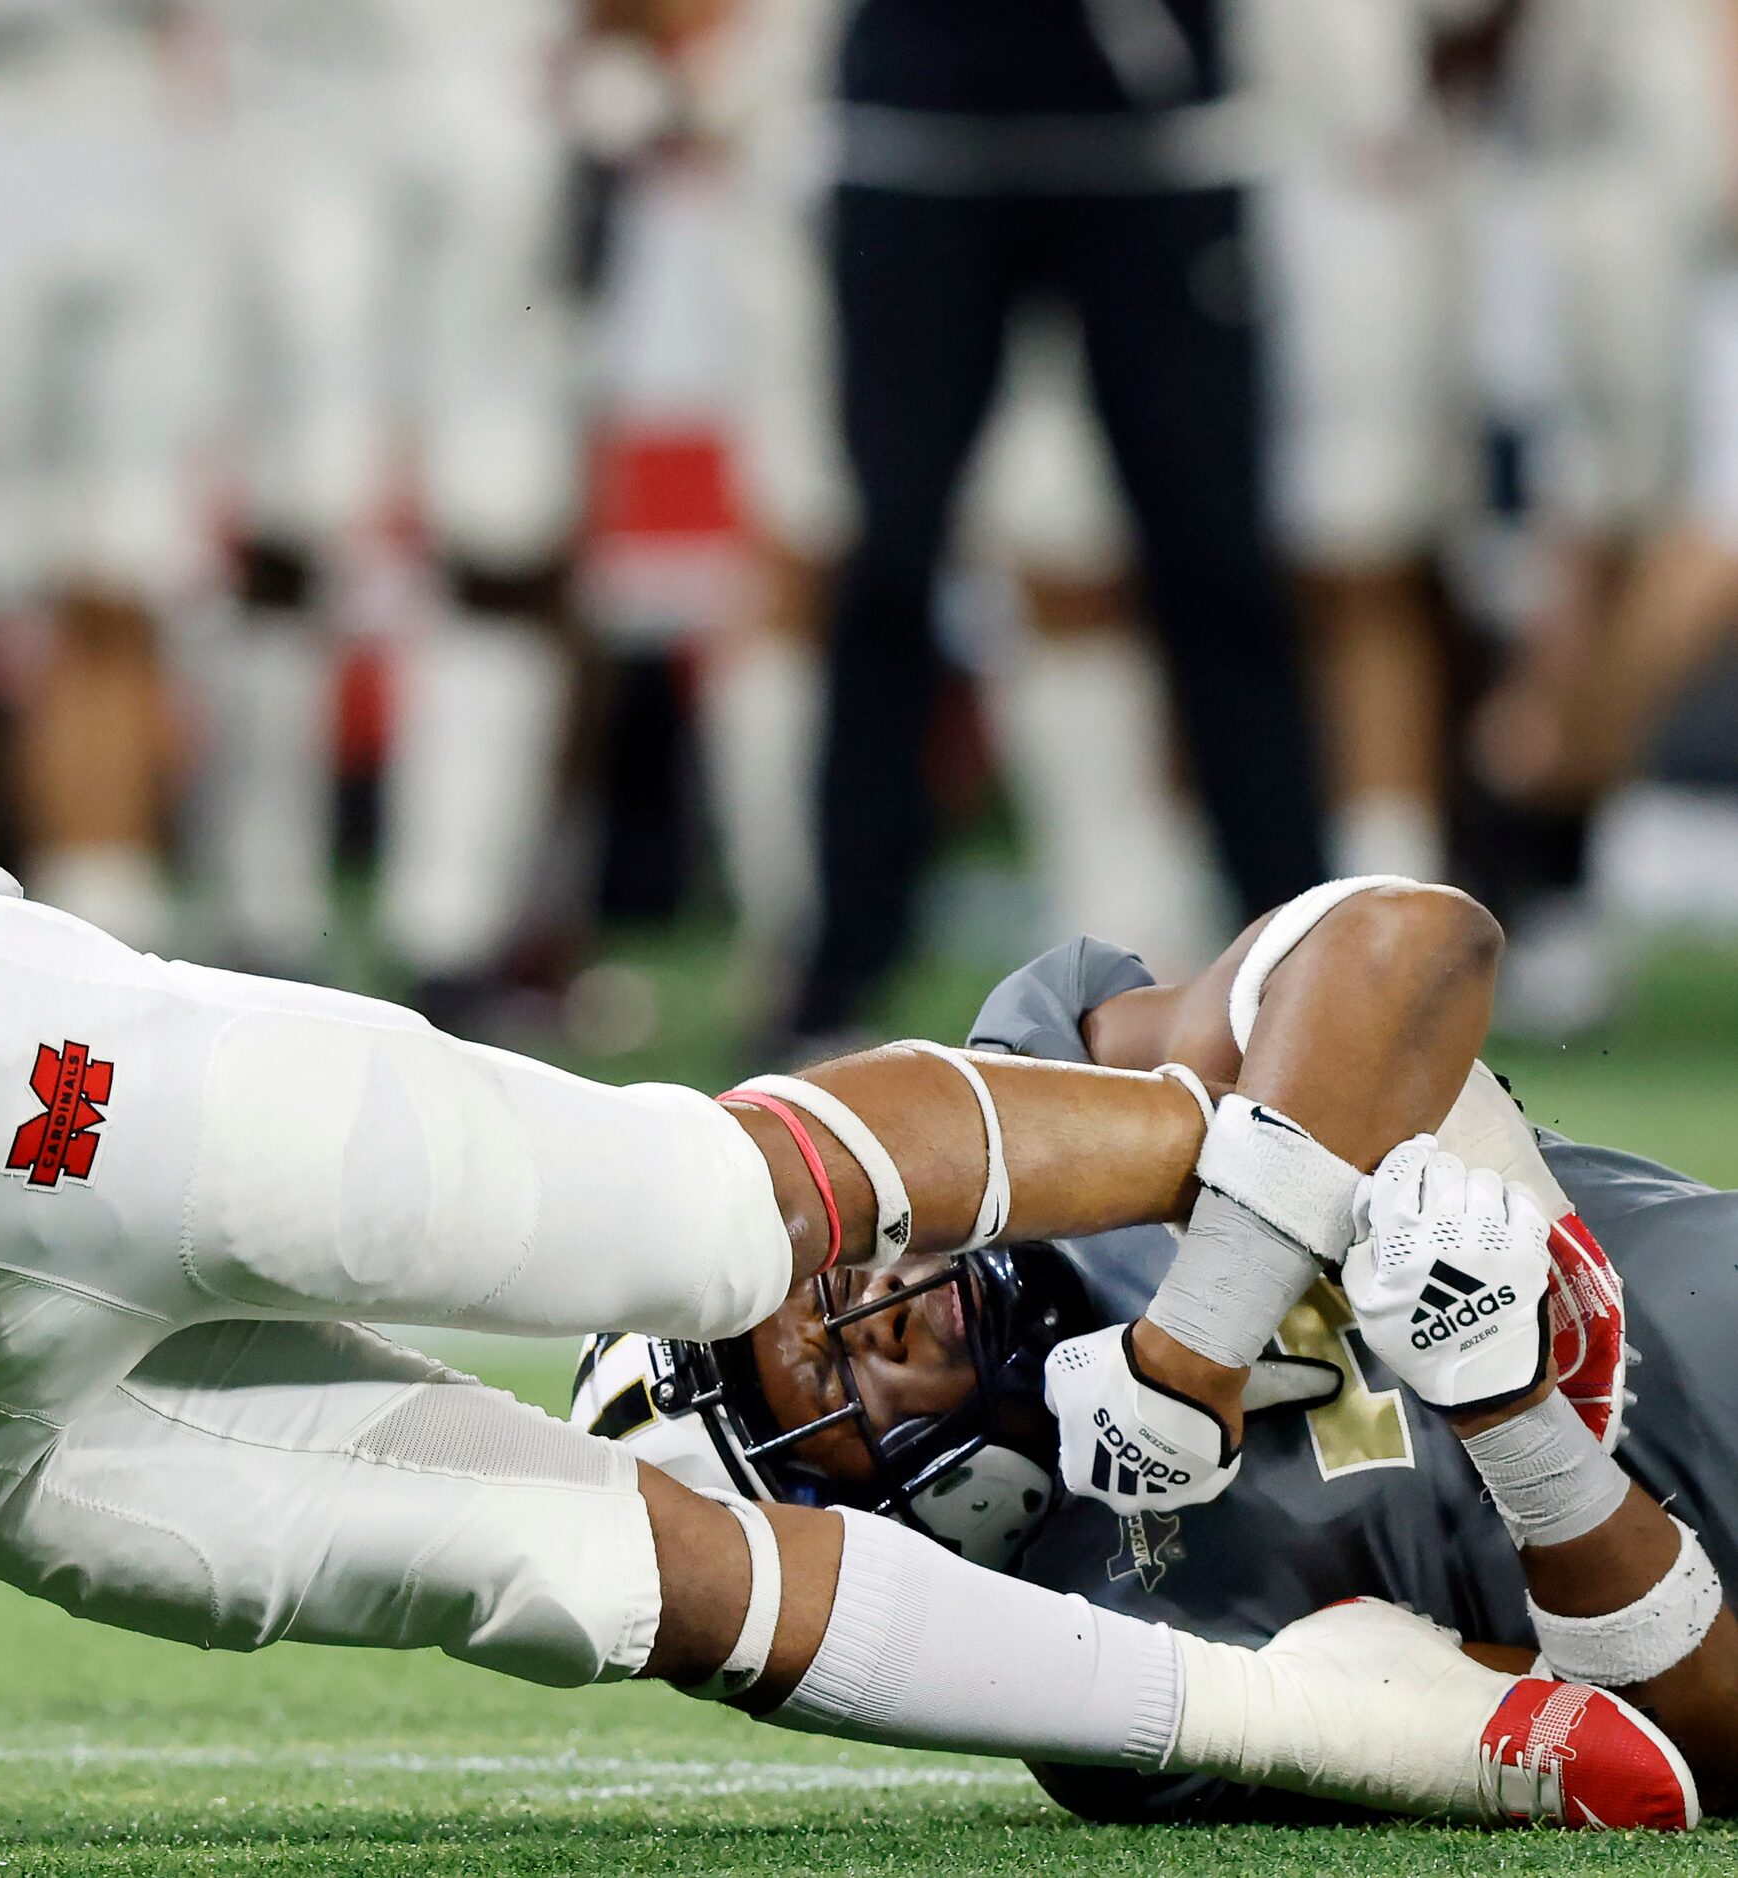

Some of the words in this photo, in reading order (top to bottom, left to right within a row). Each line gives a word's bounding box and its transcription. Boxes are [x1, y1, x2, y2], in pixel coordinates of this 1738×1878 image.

[42, 1054, 80, 1169] CARDINALS
[1411, 1284, 1516, 1350] adidas
[1459, 1324, 1499, 1352] ADIZERO
[1093, 1407, 1191, 1485] adidas
